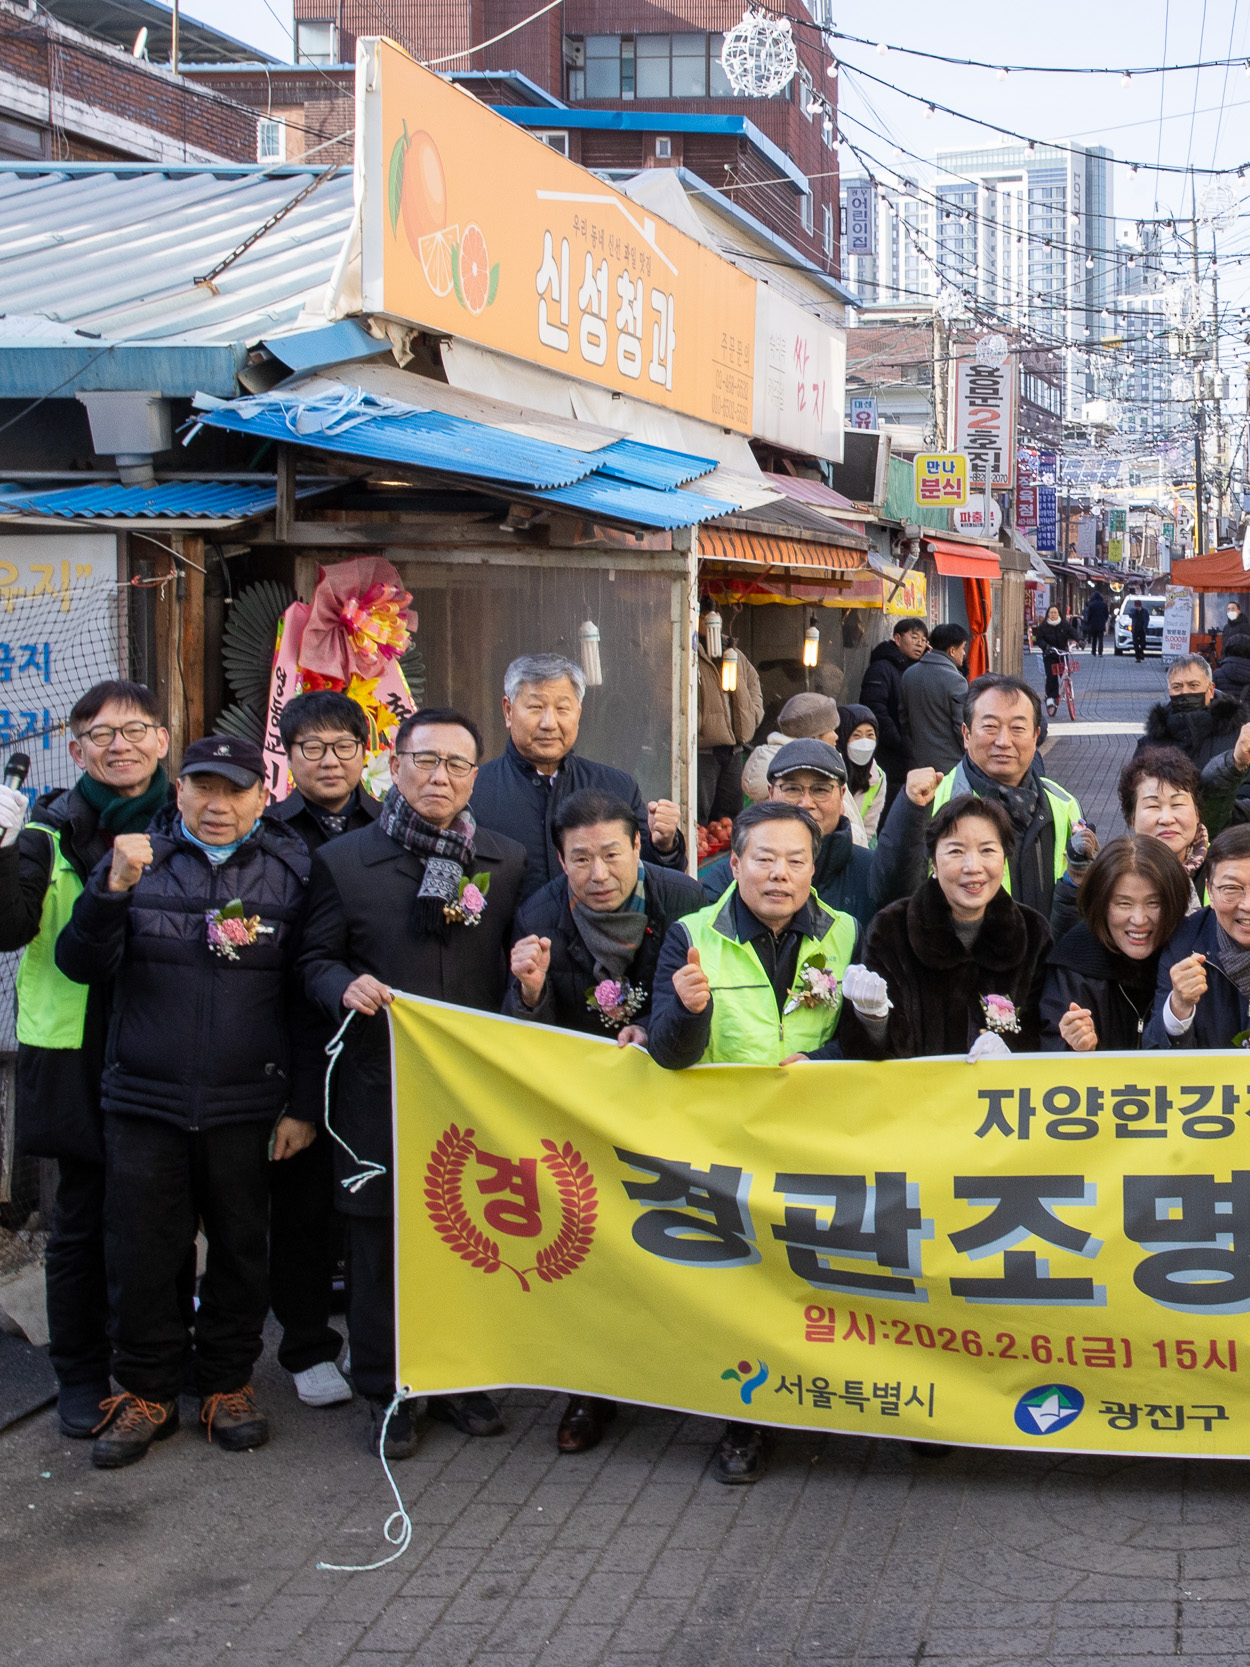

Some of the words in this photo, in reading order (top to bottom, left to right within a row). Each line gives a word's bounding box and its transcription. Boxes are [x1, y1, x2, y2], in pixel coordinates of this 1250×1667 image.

[573, 214, 587, 242] 우리
[590, 224, 605, 251] 동네
[623, 243, 637, 270] 과일
[851, 197, 868, 248] 어린이집
[536, 229, 677, 392] 신성청과
[720, 331, 750, 371] 주문문의
[963, 364, 1004, 474] 용문2호집
[920, 478, 962, 500] 분식
[926, 460, 956, 475] 만나
[970, 473, 1008, 483] -882-2070
[1165, 636, 1188, 644] 5,000원
[474, 1148, 543, 1239] 경
[803, 1303, 1133, 1371] 일시:2026.2.6.(금)
[1152, 1339, 1238, 1373] 15시
[774, 1374, 936, 1419] 서울특별시
[1098, 1399, 1230, 1432] 광진구
